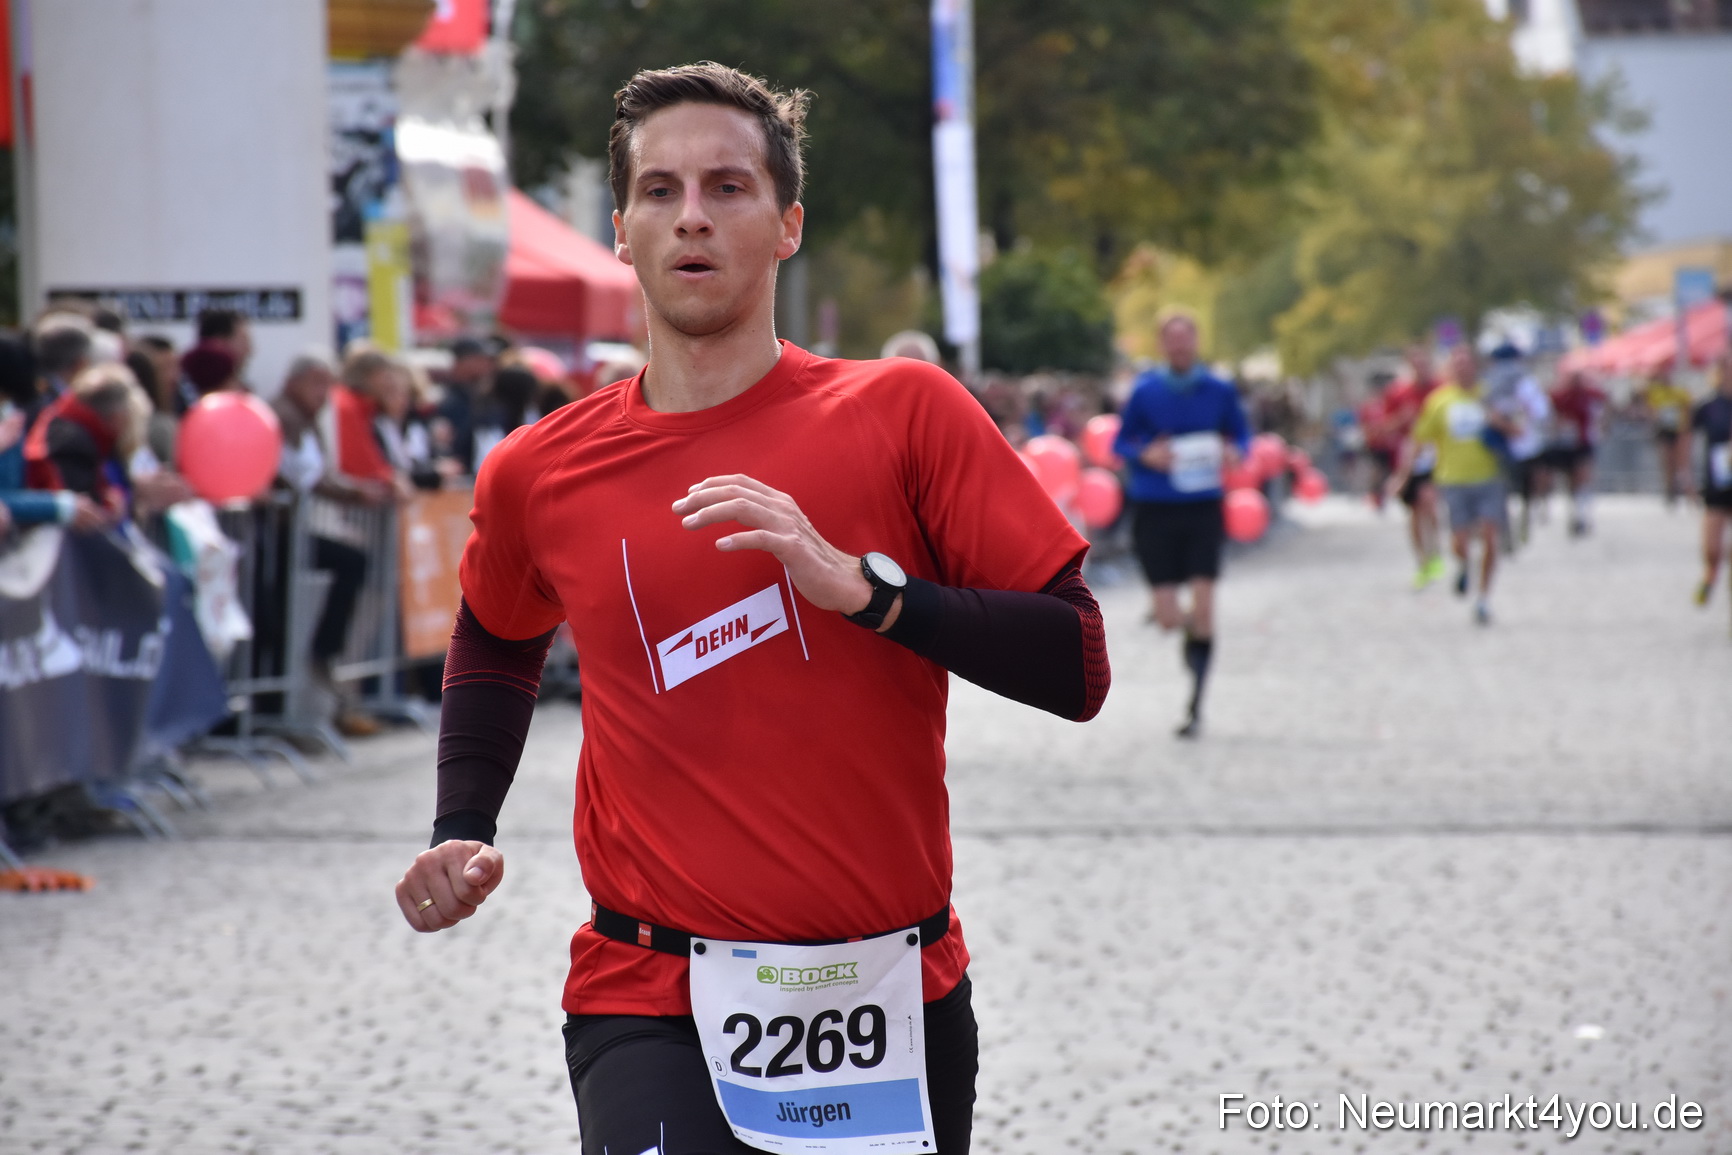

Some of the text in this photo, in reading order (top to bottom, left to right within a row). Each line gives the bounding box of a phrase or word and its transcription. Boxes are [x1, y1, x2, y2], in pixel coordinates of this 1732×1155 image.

[695, 613, 749, 660] DEHN
[780, 962, 858, 985] BOCK
[780, 985, 805, 993] inspired
[815, 982, 831, 990] smart
[832, 979, 859, 987] concepts
[723, 1004, 887, 1078] 2269
[776, 1102, 851, 1127] Jürgen
